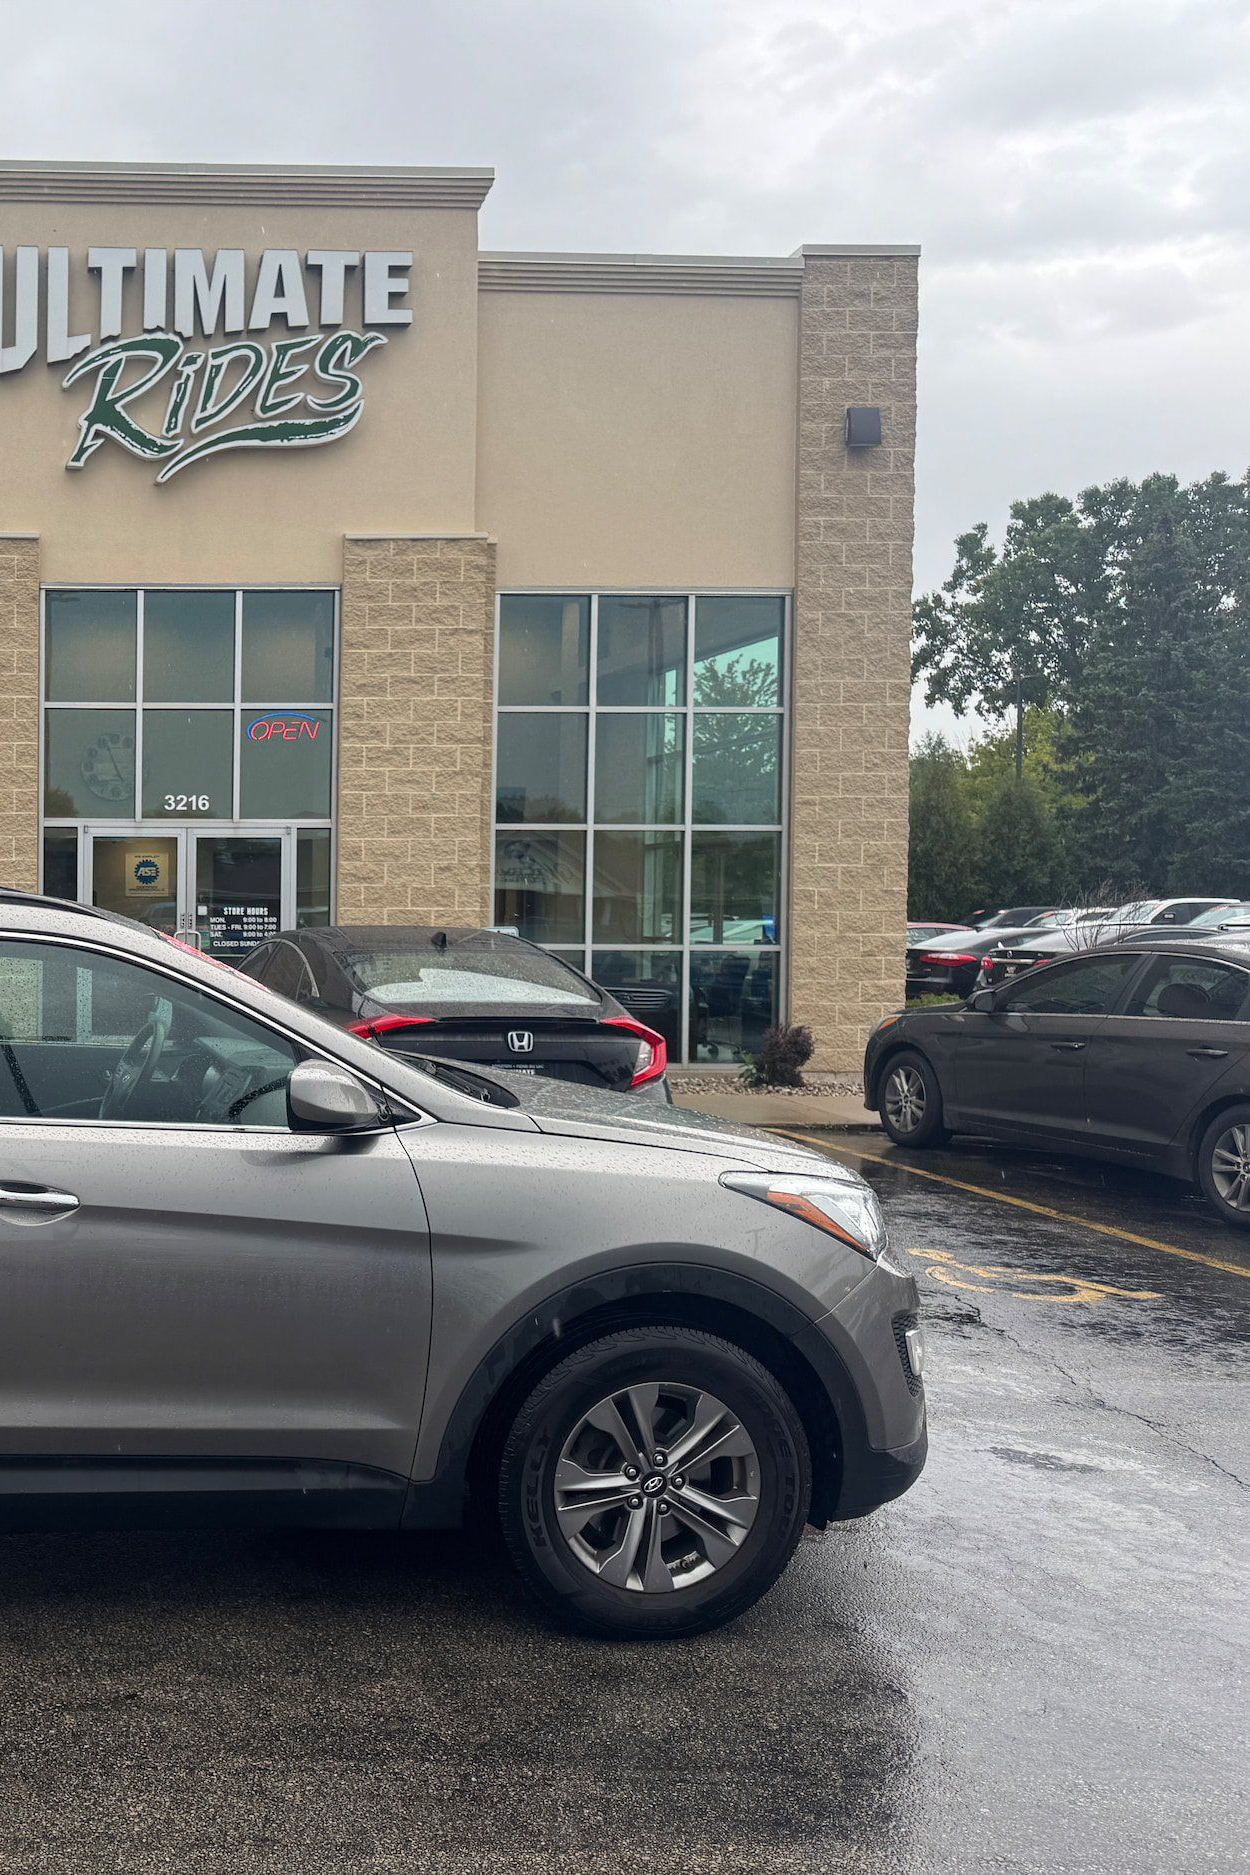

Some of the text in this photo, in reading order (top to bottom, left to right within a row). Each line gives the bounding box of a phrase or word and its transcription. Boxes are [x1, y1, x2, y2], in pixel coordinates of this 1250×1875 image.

[250, 721, 321, 741] OPEN
[163, 794, 210, 811] 3216
[223, 906, 269, 916] STORE HOURS
[528, 1425, 552, 1549] KELLY
